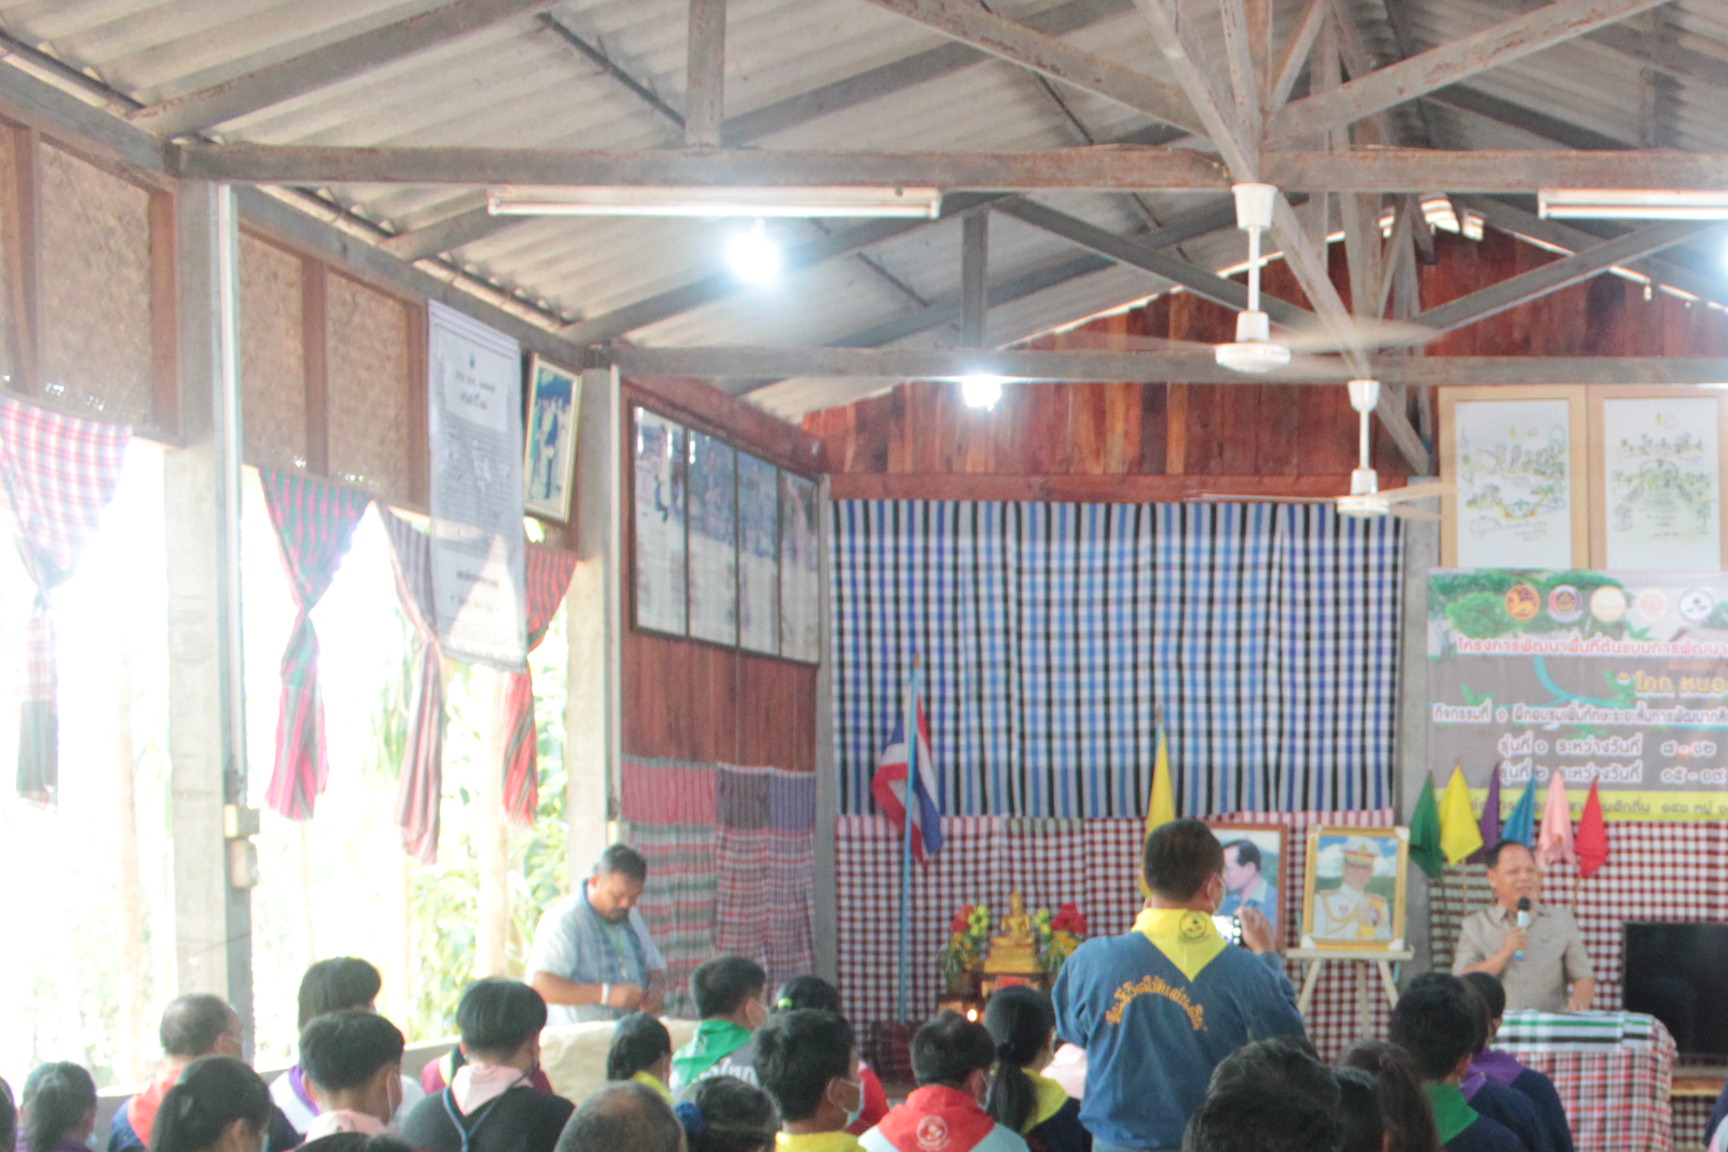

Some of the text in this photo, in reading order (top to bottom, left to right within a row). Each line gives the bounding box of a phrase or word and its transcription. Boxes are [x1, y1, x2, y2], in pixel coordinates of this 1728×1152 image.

[1634, 669, 1673, 692] โคก
[1558, 735, 1640, 753] ระหว่างวันที่
